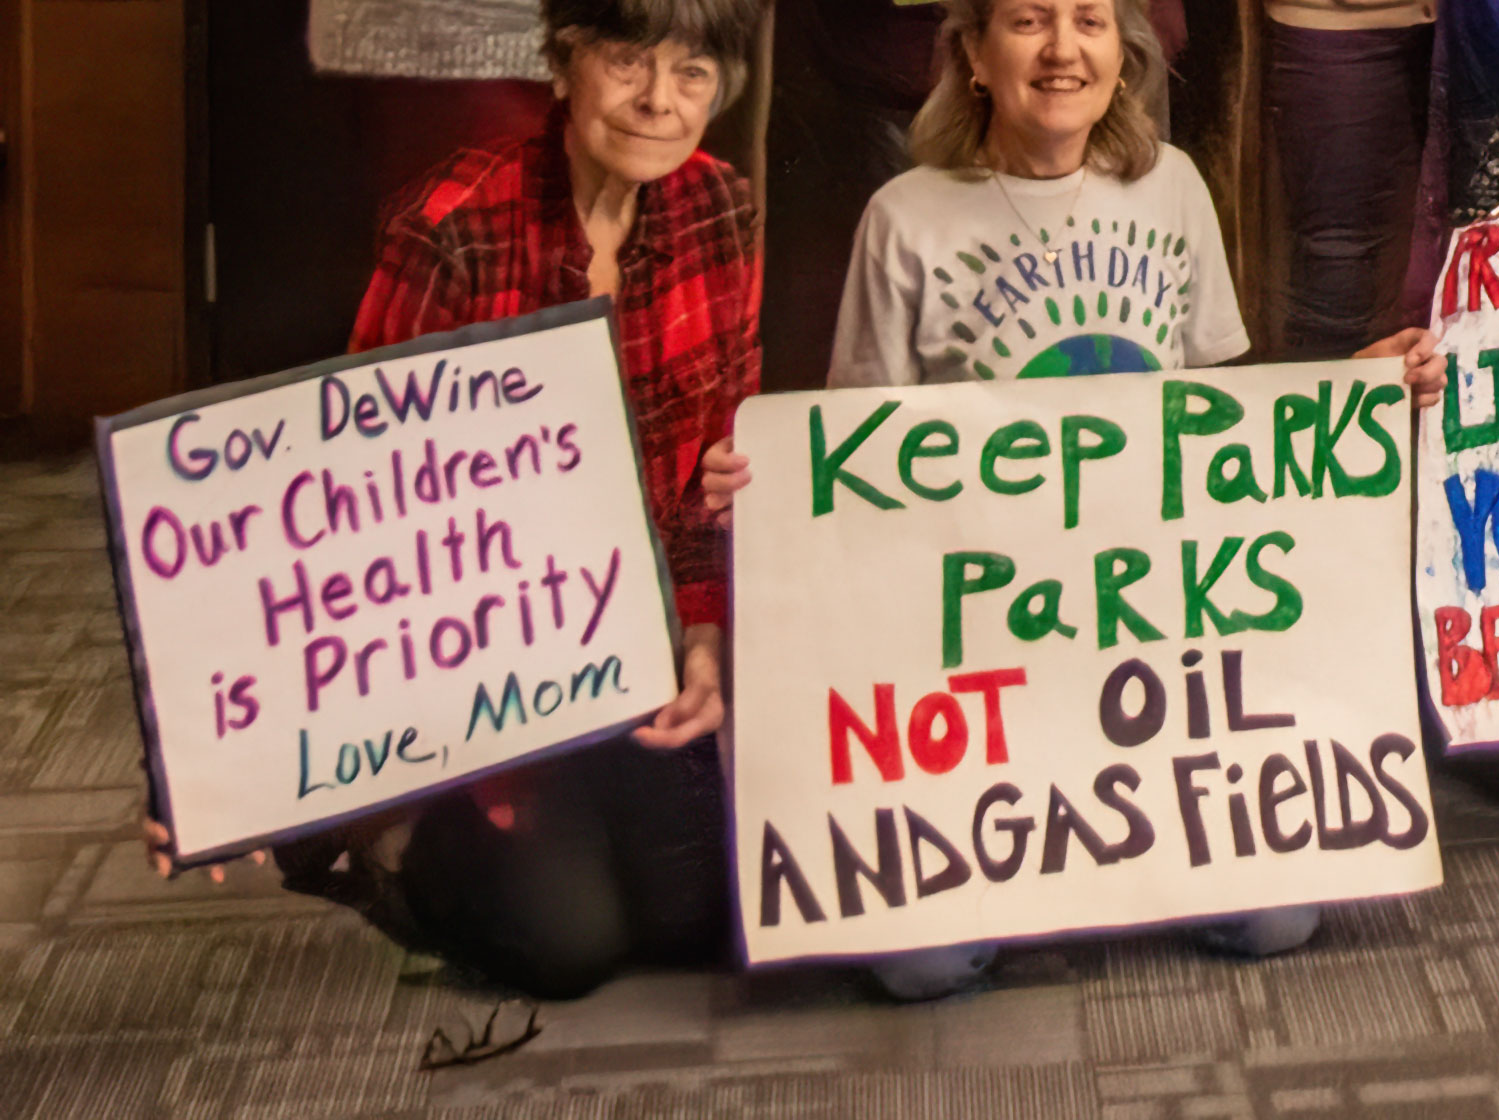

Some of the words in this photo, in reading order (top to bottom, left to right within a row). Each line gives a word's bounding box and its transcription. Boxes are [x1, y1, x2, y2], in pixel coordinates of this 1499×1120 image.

[973, 240, 1097, 327] EARTH
[1107, 246, 1171, 308] DAY
[168, 413, 292, 479] Gov.
[321, 359, 544, 441] DeWine
[141, 505, 262, 580] Our
[281, 423, 581, 549] Children's
[211, 672, 260, 739] is
[304, 547, 622, 711] Priority
[258, 508, 522, 647] Health
[297, 725, 449, 799] Love,
[465, 654, 629, 742] Mom
[828, 667, 1027, 785] NOT
